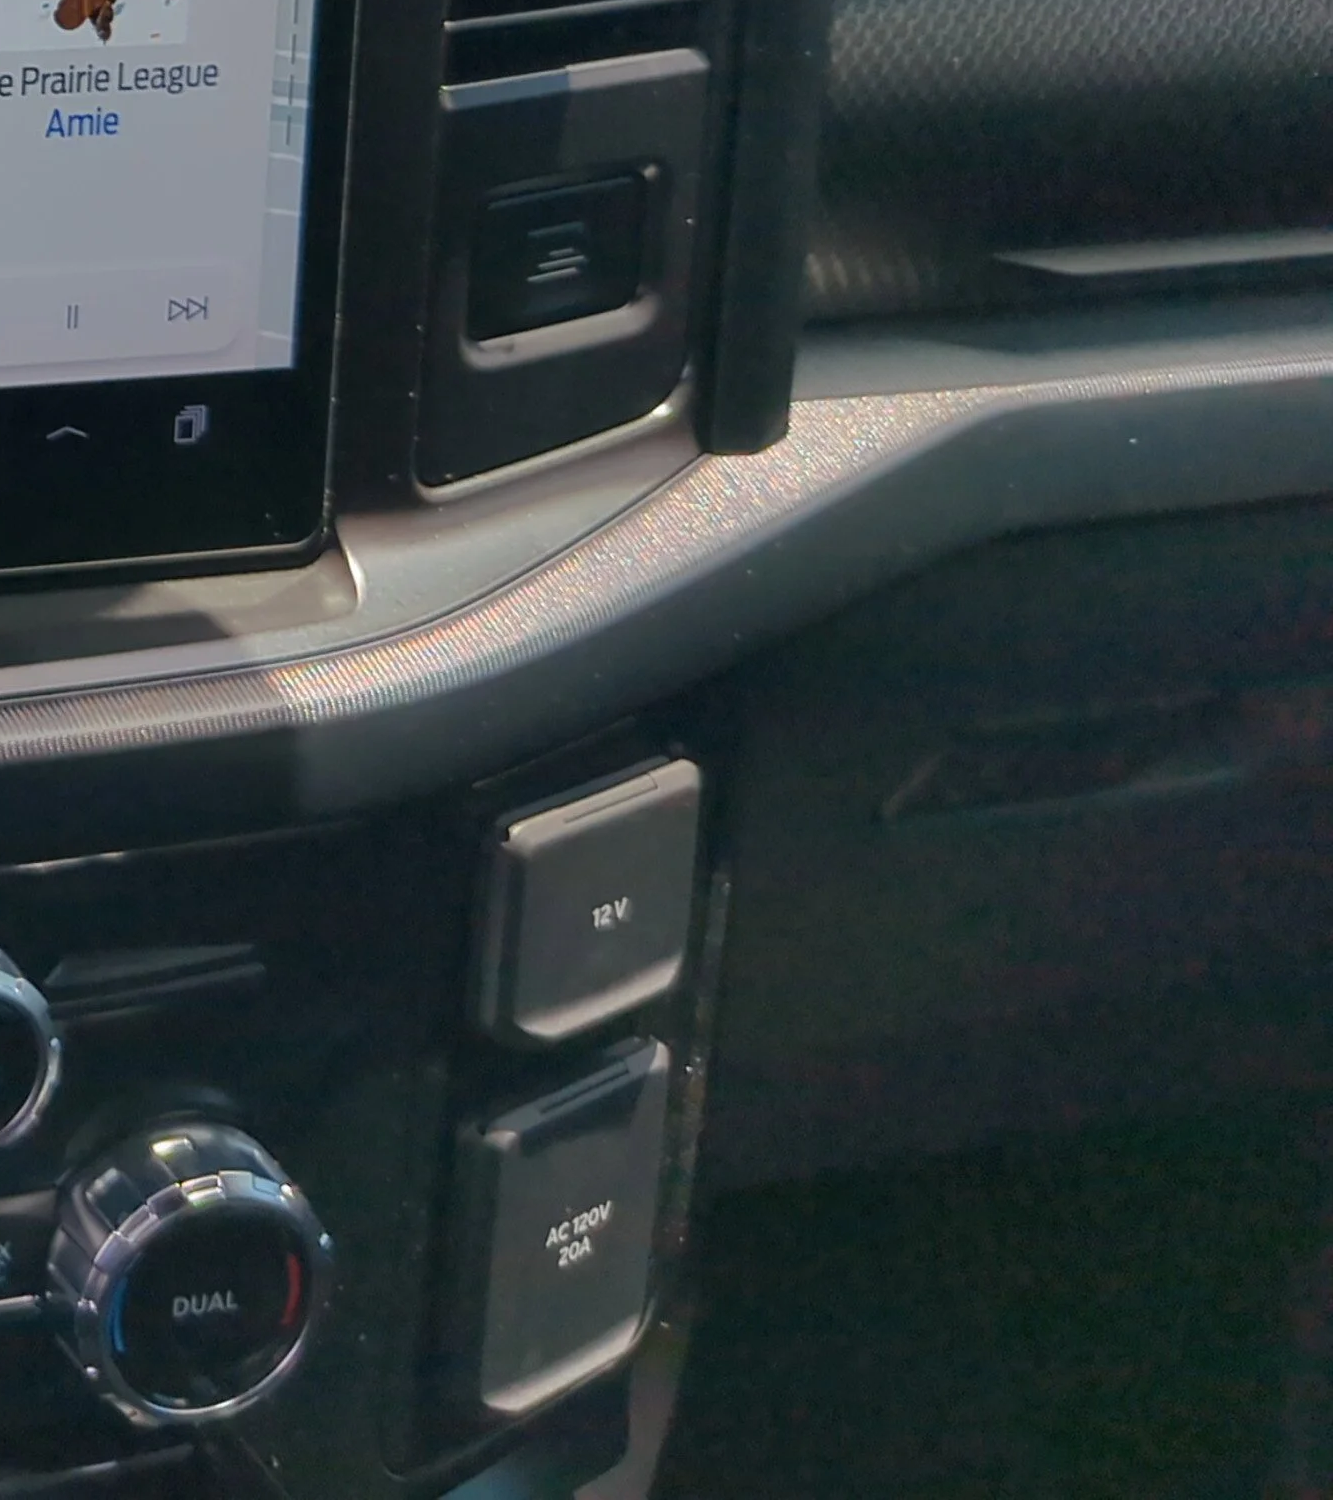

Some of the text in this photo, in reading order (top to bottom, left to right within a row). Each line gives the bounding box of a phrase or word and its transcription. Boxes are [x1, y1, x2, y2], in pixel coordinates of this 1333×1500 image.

[21, 63, 110, 96] Prairie
[117, 60, 219, 97] League
[44, 107, 120, 139] Amie
[590, 897, 629, 930] 12V
[545, 1199, 613, 1248] AC 120V
[557, 1235, 593, 1267] 20A
[172, 1291, 238, 1318] DUAL
